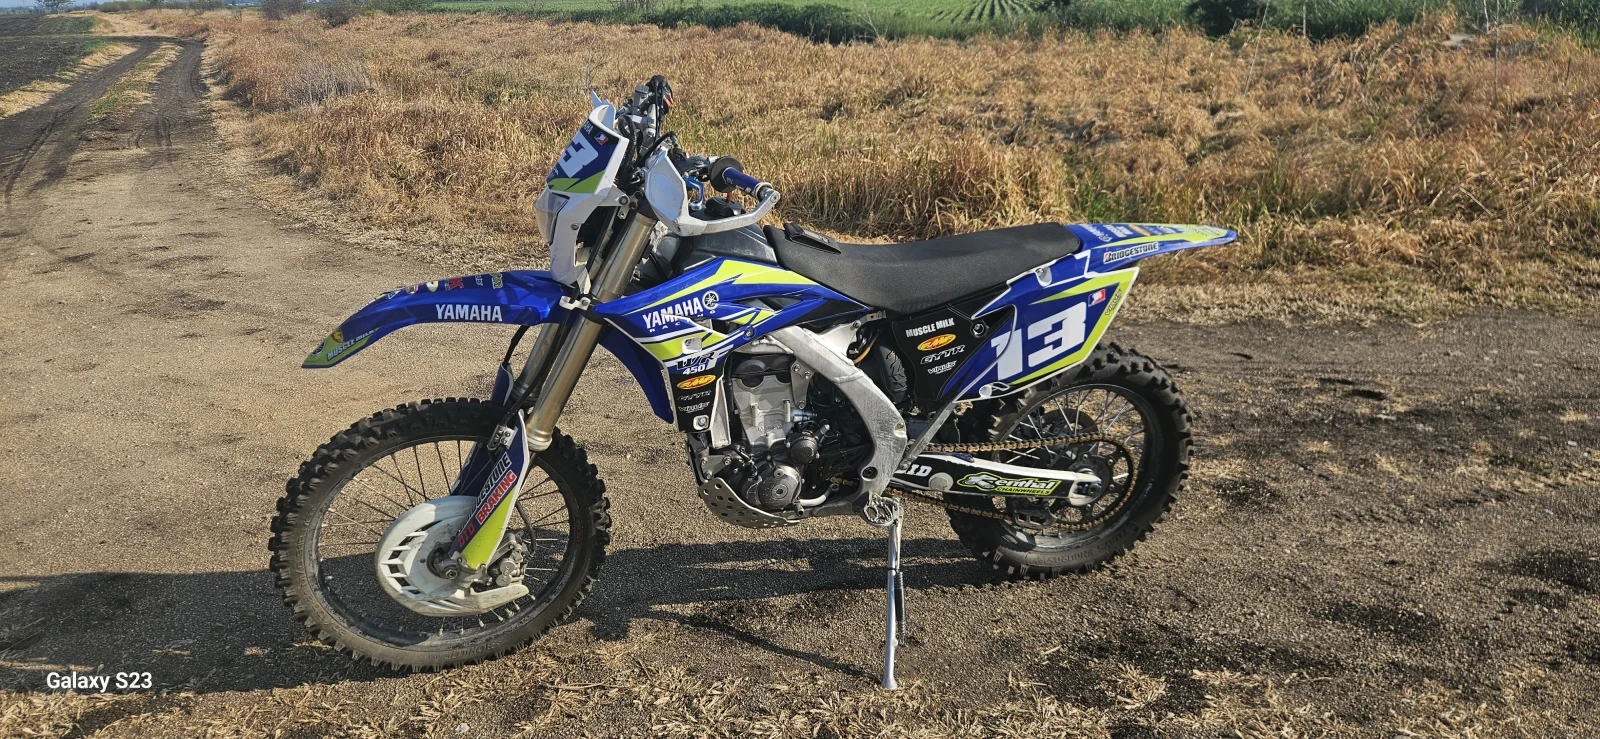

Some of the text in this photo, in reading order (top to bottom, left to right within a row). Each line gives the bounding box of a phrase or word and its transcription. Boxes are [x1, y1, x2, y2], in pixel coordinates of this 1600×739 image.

[1104, 242, 1158, 263] BRIDGESTONE
[435, 304, 503, 322] YAMAHA
[642, 297, 704, 329] YAMAHA
[905, 317, 955, 338] MUSCLE MILK
[327, 339, 355, 361] MUSCLE
[991, 302, 1087, 381] 13
[682, 364, 706, 375] 450
[476, 470, 517, 525] BRAKING
[997, 486, 1051, 495] CHAINWHEELS
